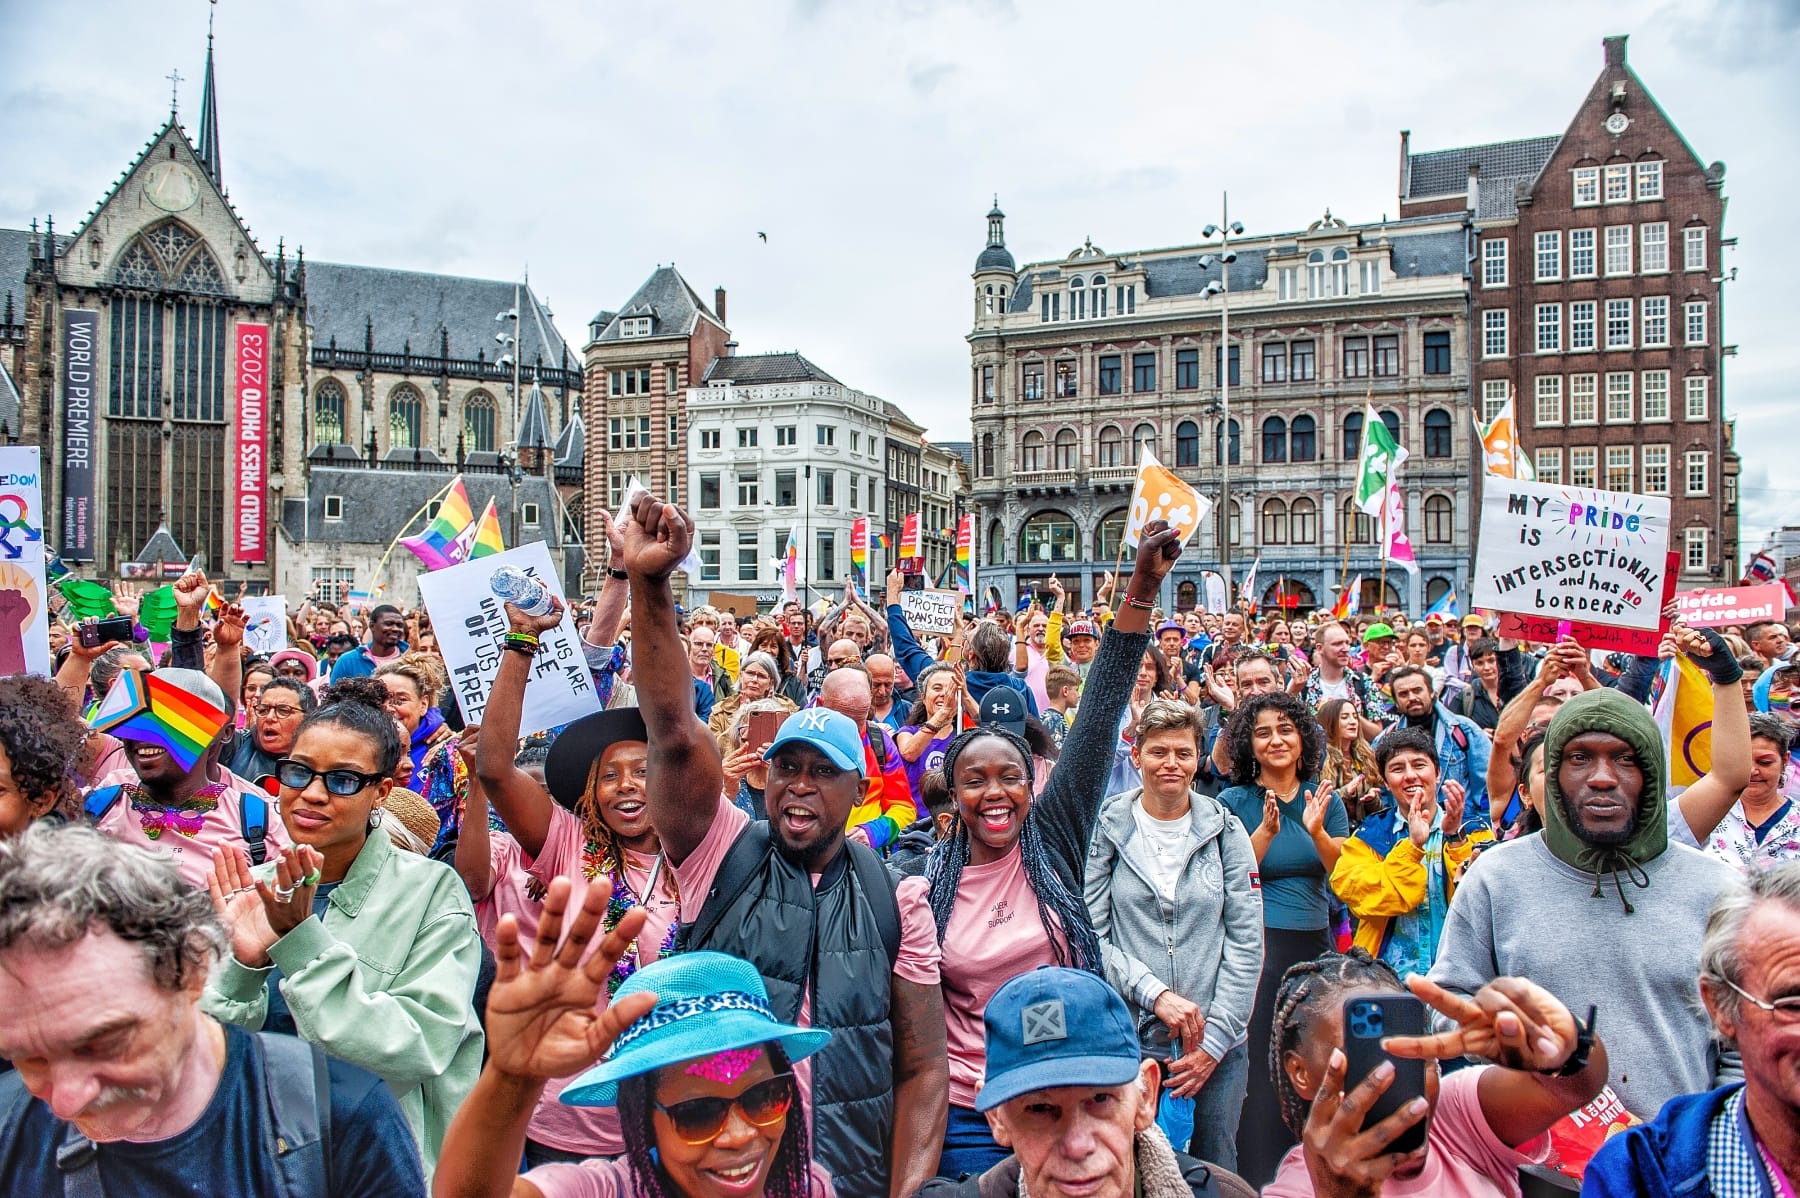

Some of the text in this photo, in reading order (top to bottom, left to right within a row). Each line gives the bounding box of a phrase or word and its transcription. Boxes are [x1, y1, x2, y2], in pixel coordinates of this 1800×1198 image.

[66, 322, 91, 469] WORLD PREMIERE
[240, 334, 263, 552] WORLD PRESS PHOTO 2023
[1508, 493, 1550, 518] MY
[1559, 570, 1642, 606] and has NO
[903, 610, 954, 627] TRANS KIDS
[908, 595, 955, 615] PROTECT
[1680, 604, 1773, 623] edereen!
[465, 614, 489, 637] OF
[475, 643, 499, 672] US
[554, 638, 573, 660] US
[564, 666, 589, 696] ARE
[454, 663, 486, 722] FREE
[799, 709, 830, 733] NY
